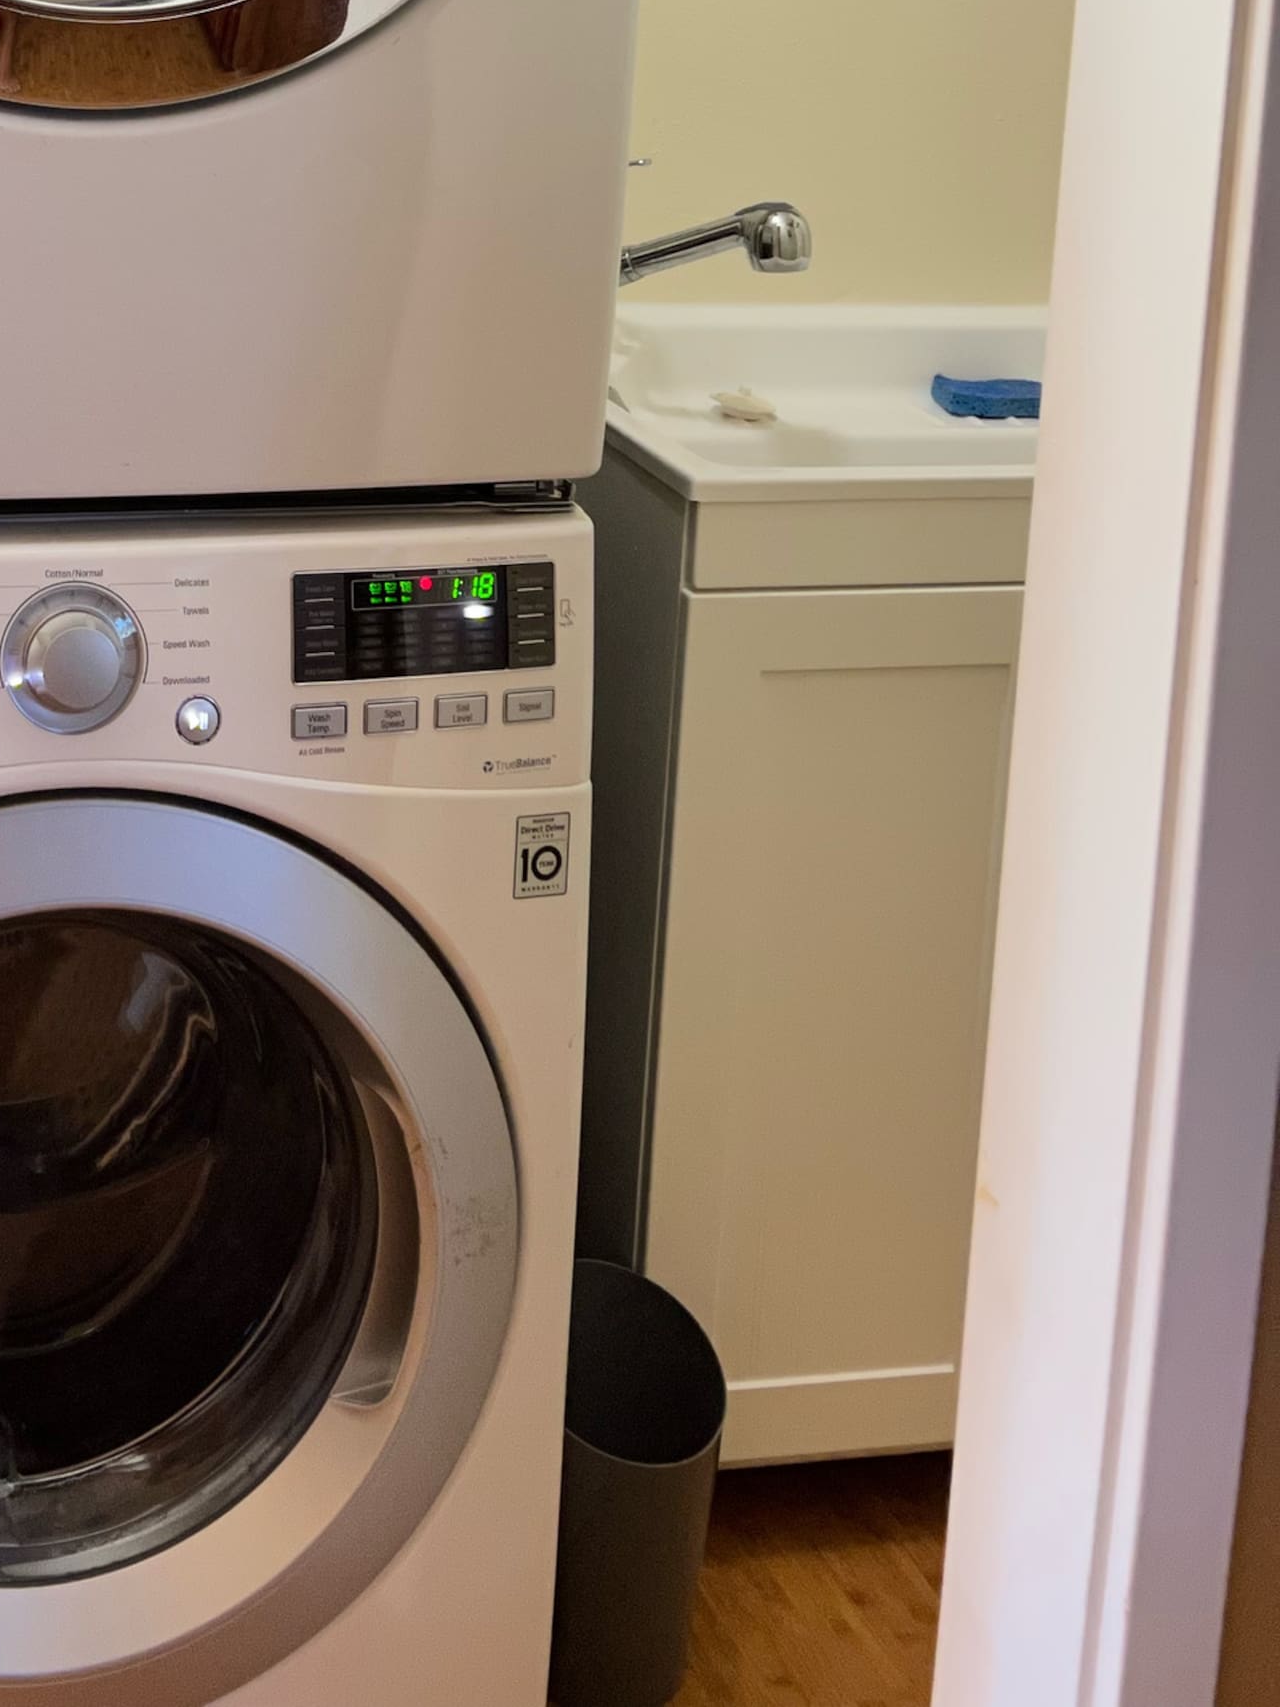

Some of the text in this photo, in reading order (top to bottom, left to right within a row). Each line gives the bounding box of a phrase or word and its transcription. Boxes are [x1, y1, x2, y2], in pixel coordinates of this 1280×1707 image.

[44, 568, 104, 579] Cotton/Normal
[174, 578, 210, 588] Delicates
[452, 572, 495, 599] 1:18
[183, 606, 210, 615] Towels
[162, 639, 211, 650] Speed Wash
[162, 675, 211, 686] Downloaded
[455, 702, 470, 713] Soil
[519, 701, 542, 713] Signal
[307, 712, 331, 723] Wash
[384, 709, 402, 719] Spin
[452, 712, 473, 724] Level
[380, 718, 406, 730] Speed
[520, 824, 565, 835] Direct Drive
[521, 845, 563, 883] 10
